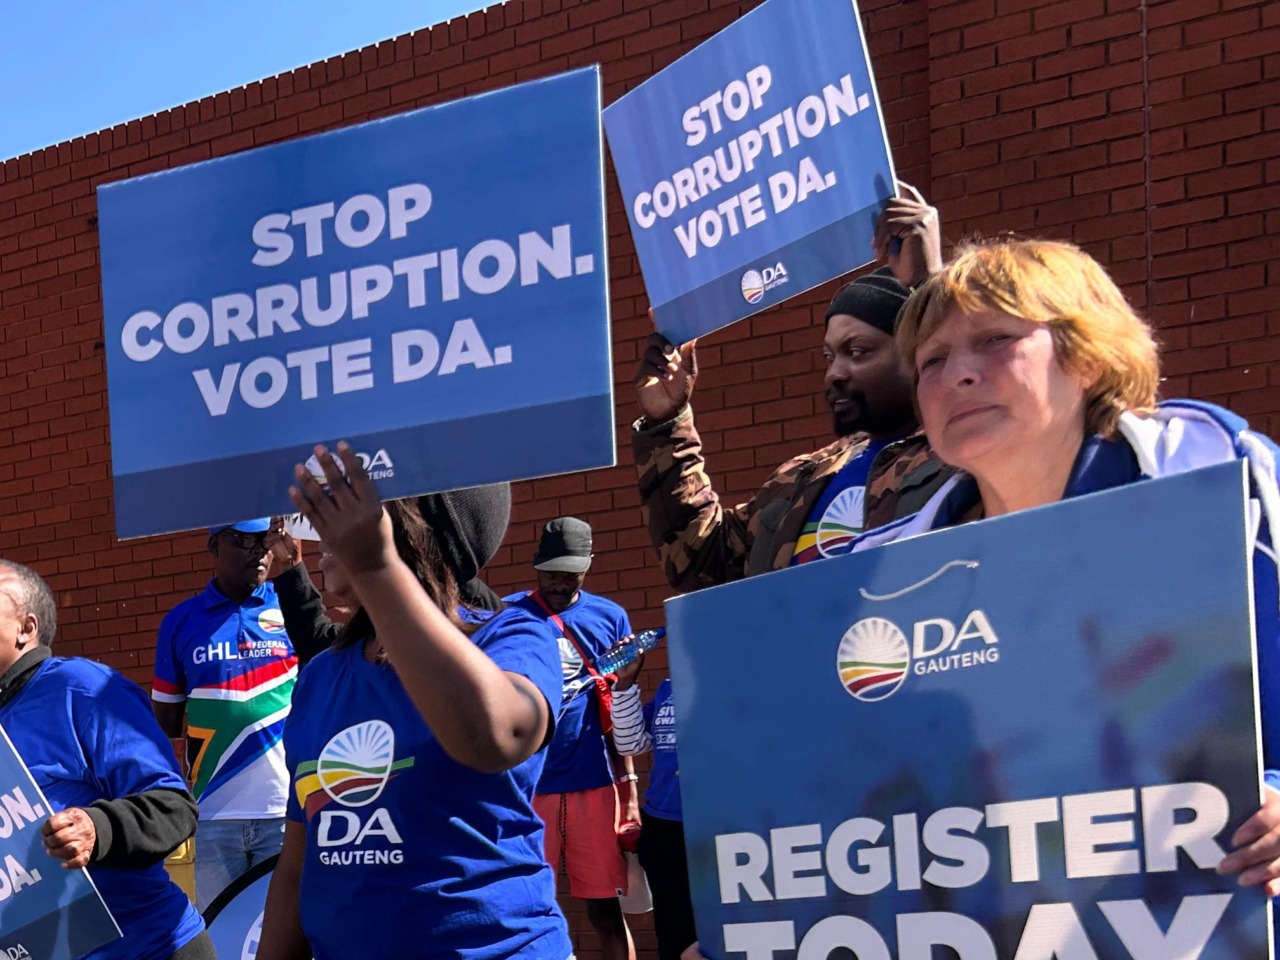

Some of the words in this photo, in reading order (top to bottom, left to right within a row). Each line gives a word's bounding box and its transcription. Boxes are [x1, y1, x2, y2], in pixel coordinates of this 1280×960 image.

[682, 64, 772, 147] STOP
[633, 73, 871, 229] CORRUPTION.
[251, 183, 433, 267] STOP
[673, 184, 767, 259] VOTE
[767, 156, 837, 214] DA.
[121, 223, 594, 362] CORRUPTION.
[762, 262, 787, 285] DA
[192, 337, 374, 417] VOTE
[391, 318, 513, 384] DA.
[367, 469, 394, 480] TENG
[192, 641, 238, 665] GHL
[252, 641, 288, 650] FEDERAL
[238, 649, 272, 660] LEADER
[912, 609, 999, 659] DA
[914, 647, 999, 675] GAUTENG
[317, 807, 404, 847] DA
[714, 781, 1231, 905] REGISTER
[319, 849, 404, 866] GAUTENG
[6, 943, 29, 960] DA
